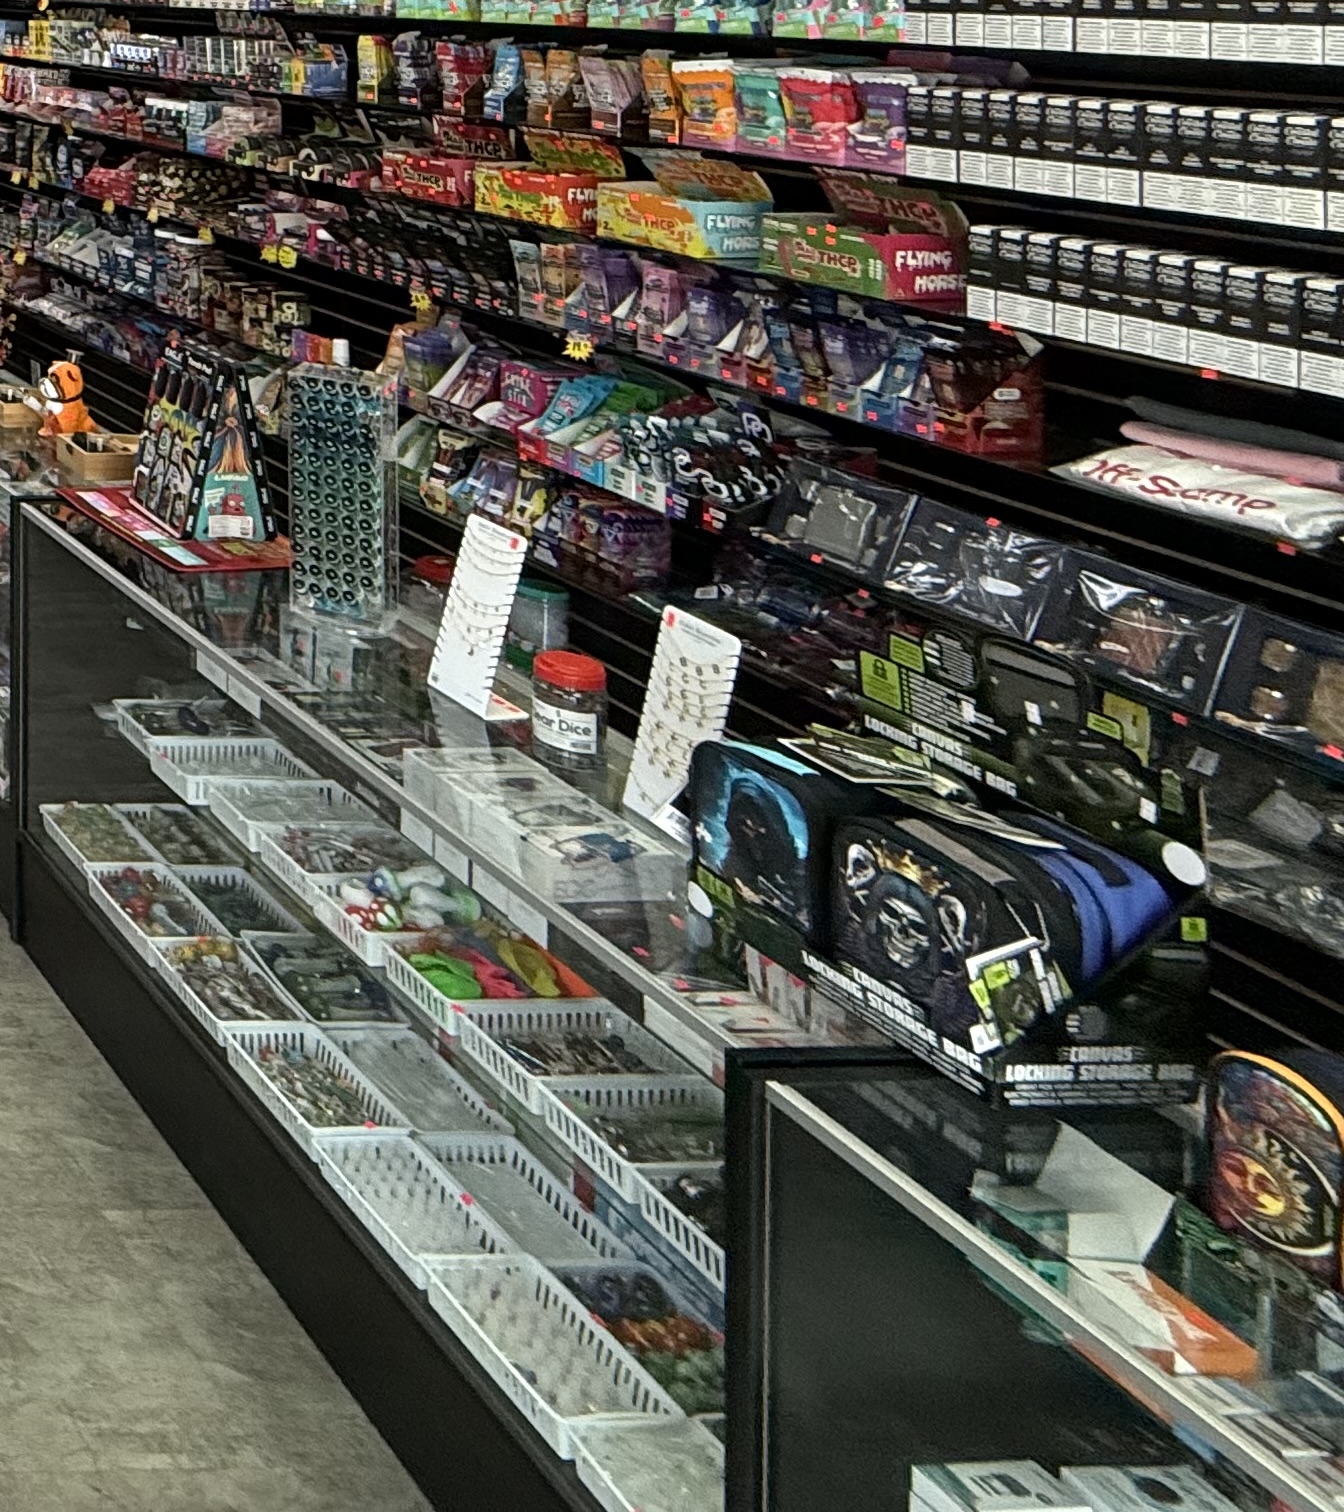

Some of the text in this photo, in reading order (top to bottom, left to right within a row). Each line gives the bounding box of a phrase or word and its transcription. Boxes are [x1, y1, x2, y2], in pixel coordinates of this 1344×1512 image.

[707, 214, 756, 231] FLYING
[722, 236, 760, 252] HORS
[818, 249, 858, 268] THCP
[895, 250, 953, 271] FLYING
[558, 719, 592, 737] Dice
[864, 714, 919, 750] LOCKING
[920, 740, 983, 781] STORAGE
[912, 722, 963, 757] CANVAS
[852, 966, 916, 1016] CANVAS
[801, 949, 866, 1001] LOCKING
[866, 990, 941, 1049] STORAGE
[942, 1036, 984, 1075] BAG
[1005, 1064, 1075, 1081] LOCKING
